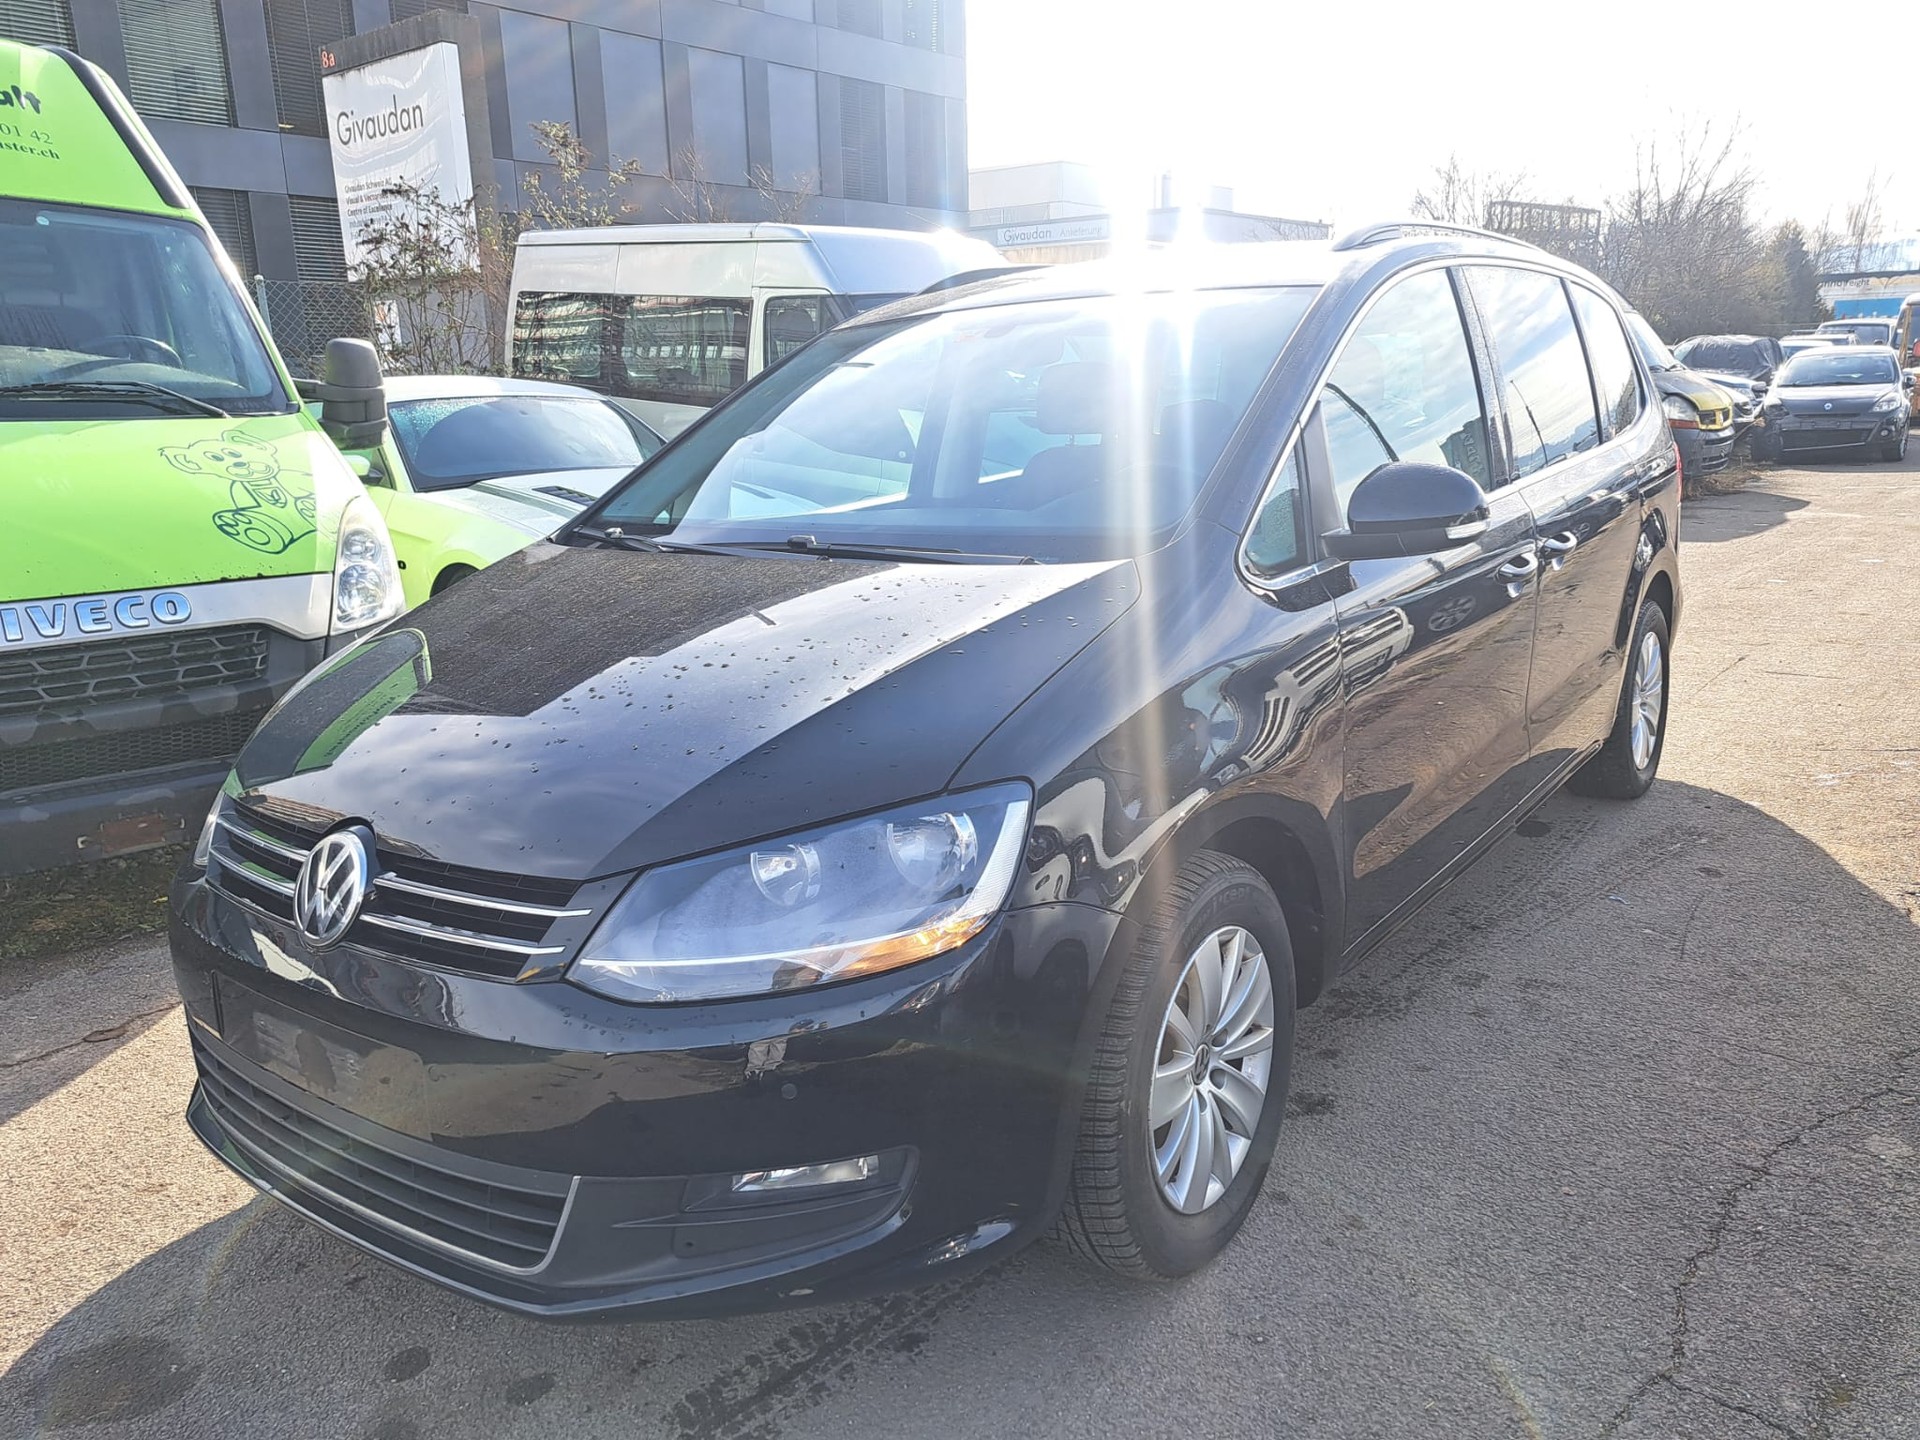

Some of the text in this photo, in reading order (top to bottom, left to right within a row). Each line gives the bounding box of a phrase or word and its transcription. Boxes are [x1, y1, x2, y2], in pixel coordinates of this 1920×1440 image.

[321, 50, 336, 68] 8a
[336, 94, 424, 145] Givaudan
[30, 130, 53, 145] 42
[1003, 226, 1052, 242] Givaudan
[0, 592, 192, 641] IVECO
